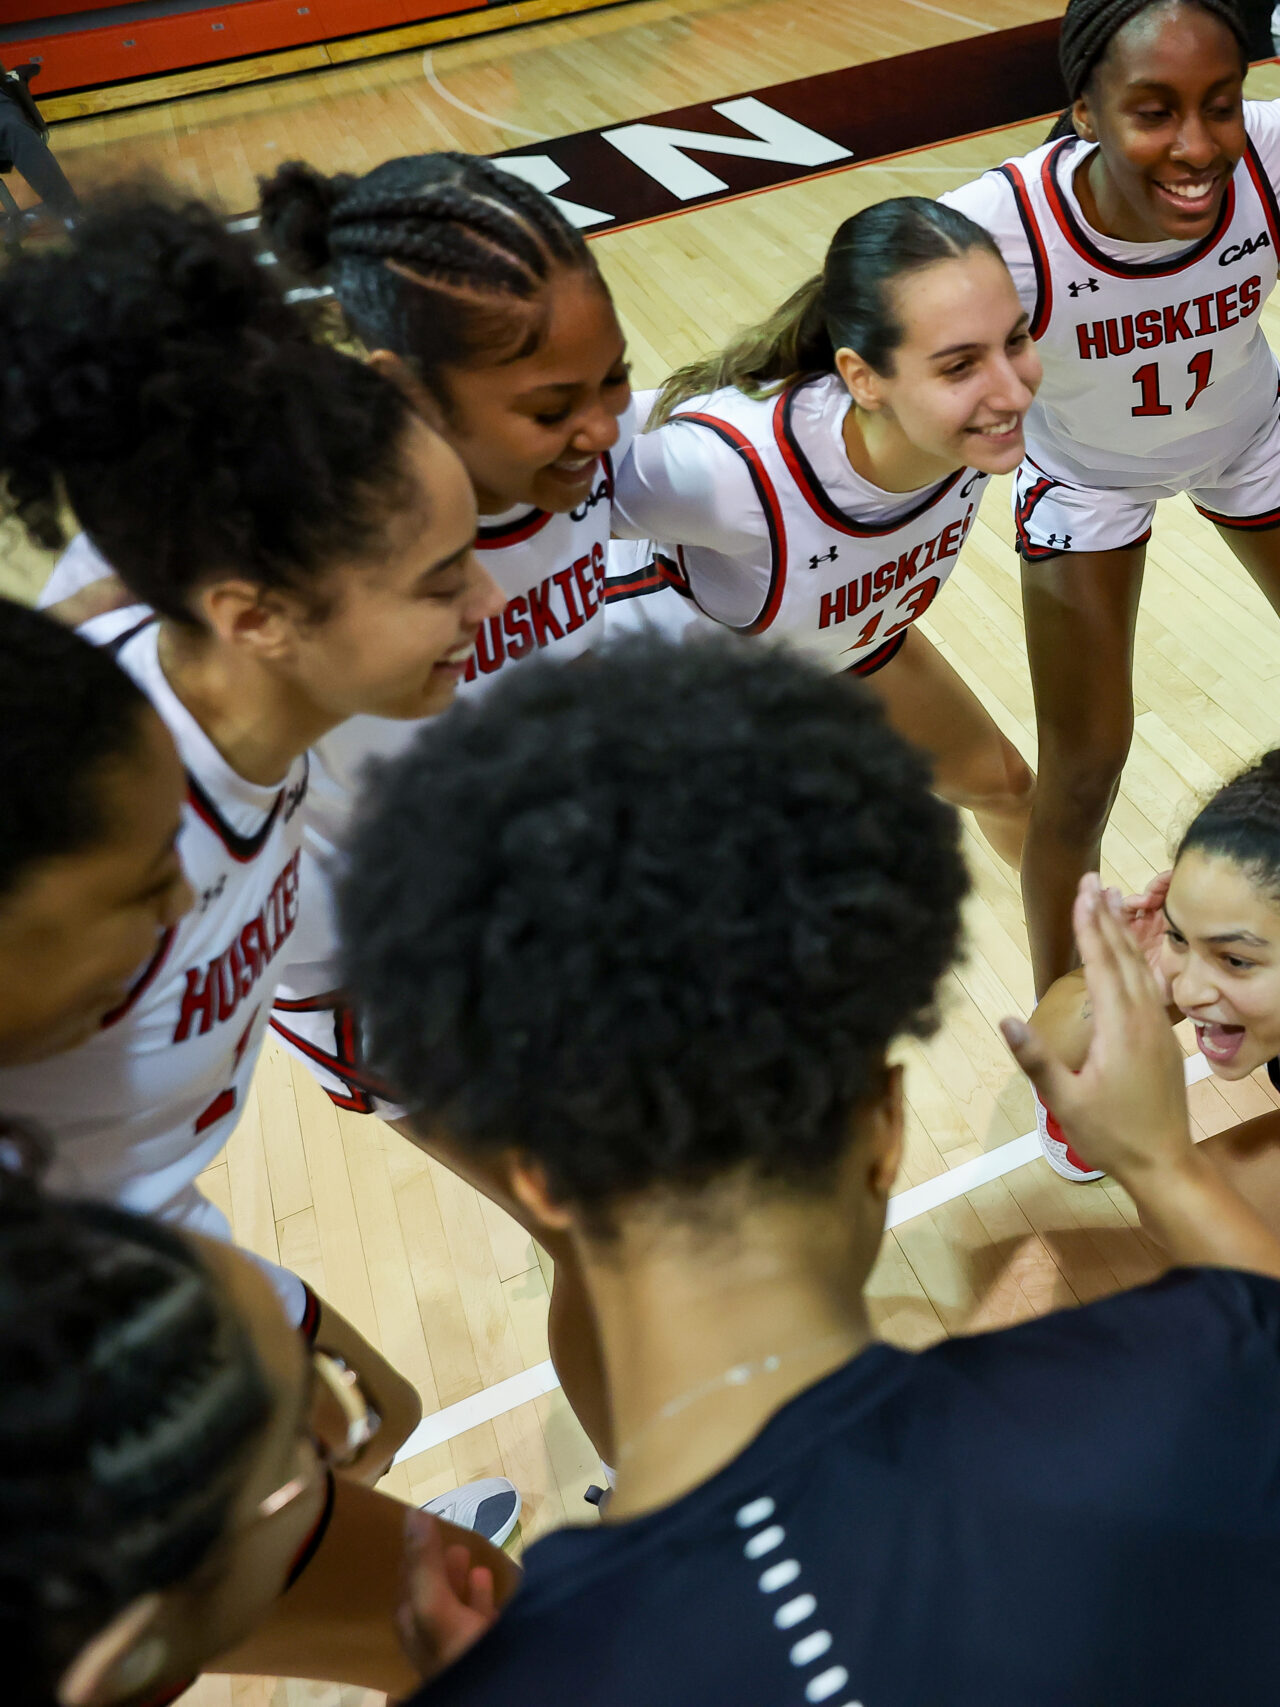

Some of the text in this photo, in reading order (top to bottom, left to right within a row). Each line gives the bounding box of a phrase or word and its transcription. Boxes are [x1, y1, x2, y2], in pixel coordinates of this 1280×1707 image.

[1218, 231, 1270, 266] CAA
[1075, 274, 1261, 360] HUSKIES
[1131, 348, 1215, 417] 11
[464, 541, 606, 683] USKIES
[839, 575, 941, 656] 13
